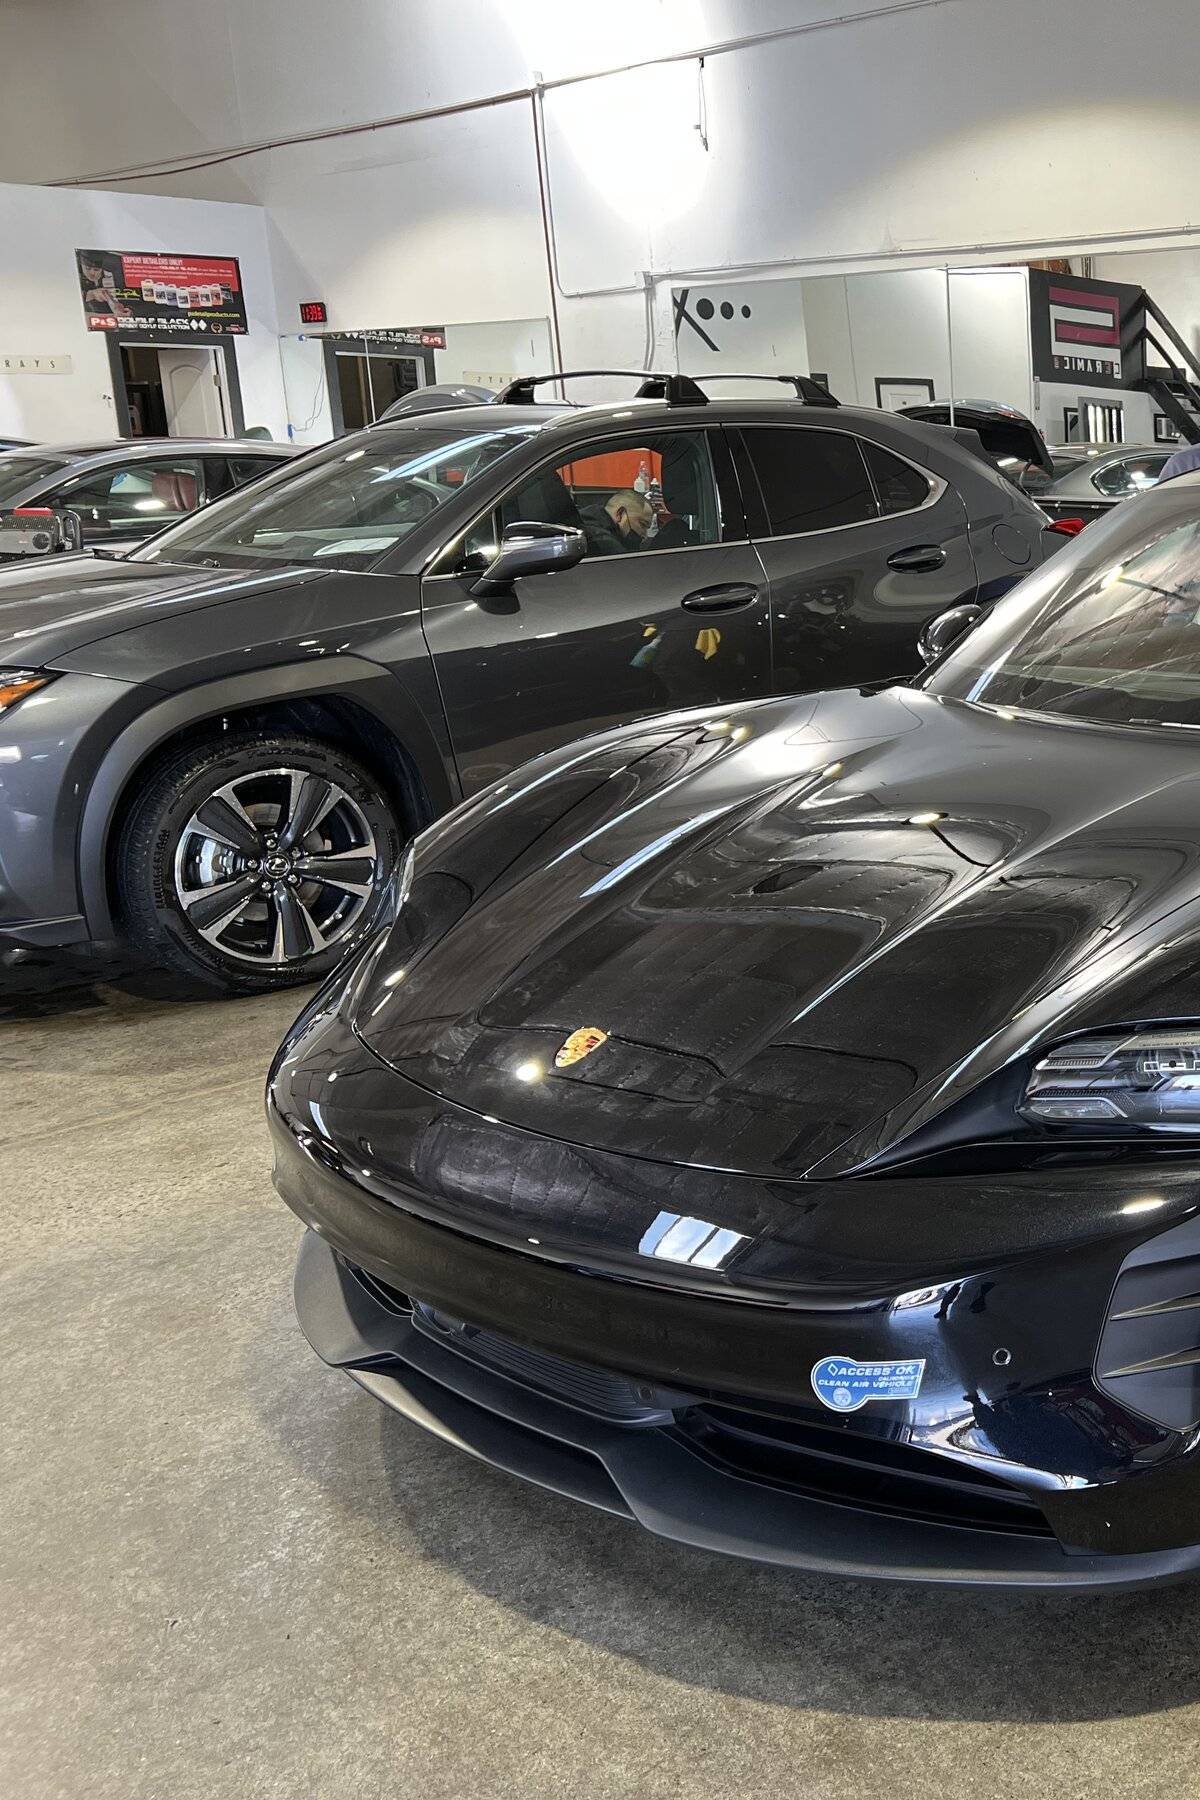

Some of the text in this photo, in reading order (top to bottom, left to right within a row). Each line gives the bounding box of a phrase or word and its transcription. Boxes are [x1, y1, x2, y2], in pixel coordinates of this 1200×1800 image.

[91, 317, 116, 326] P&S
[838, 1366, 916, 1376] ACCESS OK
[818, 1379, 850, 1387] CLEAN
[873, 1380, 913, 1388] VEHICLE
